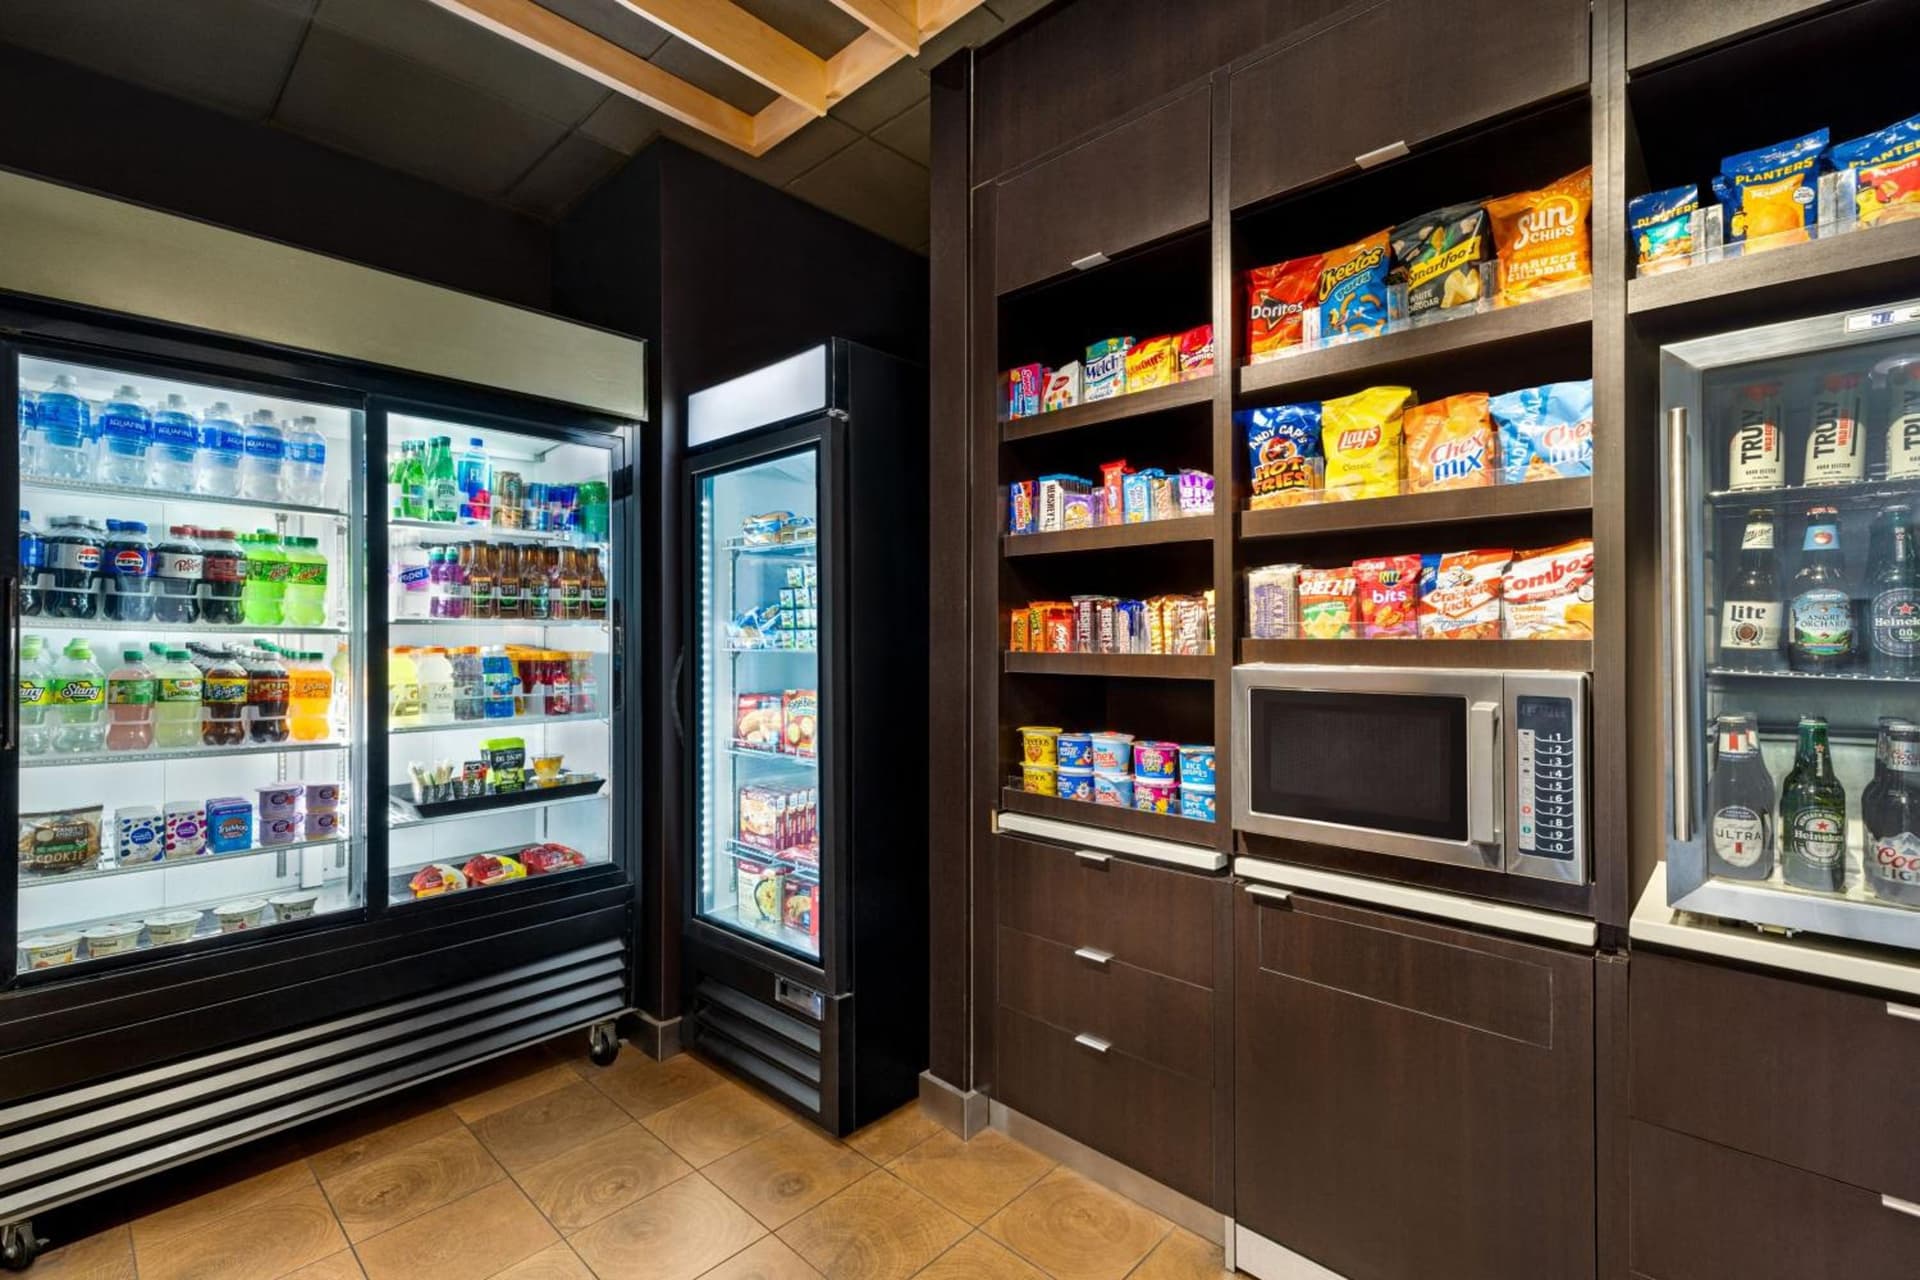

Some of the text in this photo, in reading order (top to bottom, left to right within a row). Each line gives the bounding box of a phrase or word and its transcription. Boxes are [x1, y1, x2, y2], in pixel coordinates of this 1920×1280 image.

[1735, 154, 1817, 185] PLANTERS
[1514, 204, 1579, 250] Sun
[1529, 224, 1576, 243] CHIPS
[1319, 248, 1384, 303] Cheetos
[1408, 243, 1477, 287] Smartfood
[1251, 301, 1303, 319] Doritos
[109, 418, 147, 432] AQUAFINA
[158, 426, 193, 439] AQUAFINA
[1543, 420, 1592, 447] Che
[1741, 409, 1763, 464] TRULY
[1814, 402, 1838, 459] TRULY
[1249, 425, 1275, 450] ANDY
[1430, 430, 1484, 464] Chex
[1256, 457, 1304, 481] HOT
[1435, 449, 1483, 480] mix
[1252, 472, 1306, 495] FRIES
[115, 558, 143, 567] PEPSI
[1503, 553, 1593, 593] Combos
[1372, 590, 1407, 603] bits
[1731, 605, 1766, 622] Lite
[19, 686, 45, 700] arry
[63, 682, 100, 699] Starry
[1715, 828, 1761, 840] ULTRA
